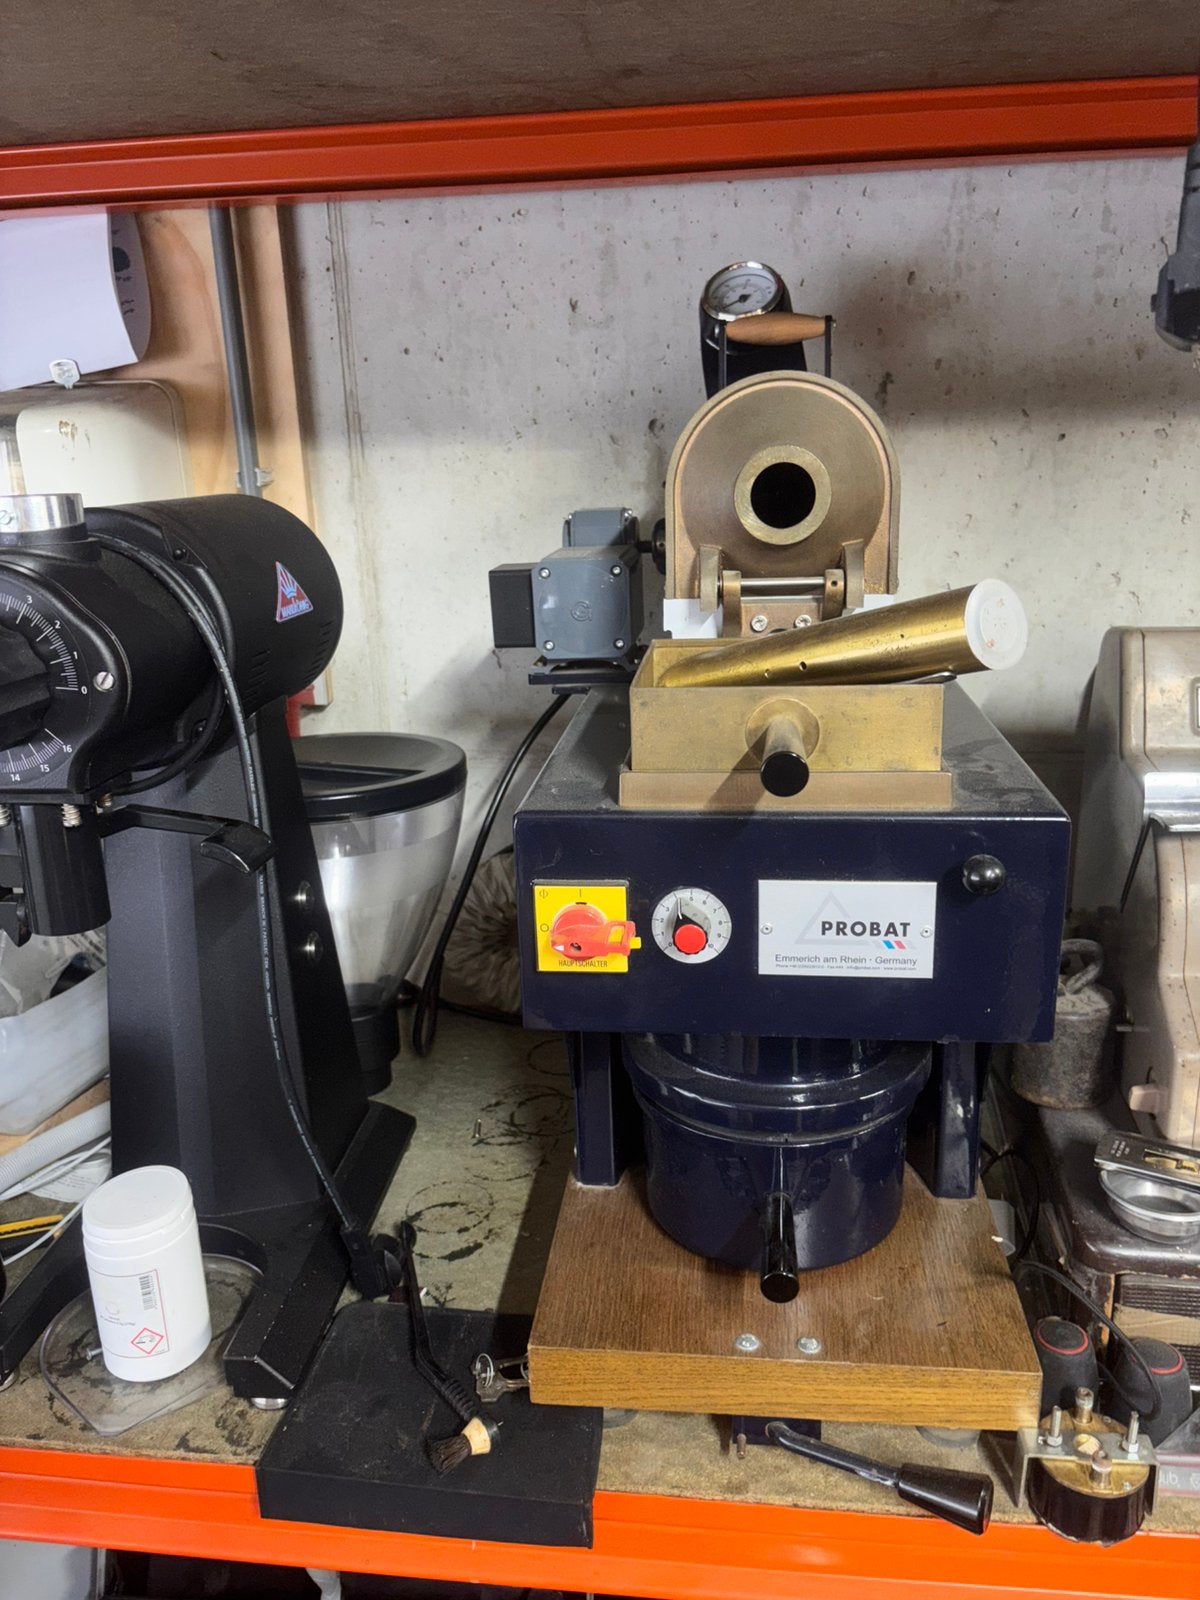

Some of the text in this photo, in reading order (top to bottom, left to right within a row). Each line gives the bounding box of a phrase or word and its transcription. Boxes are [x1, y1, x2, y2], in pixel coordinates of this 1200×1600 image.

[26, 595, 33, 604] 3
[54, 620, 61, 629] 2
[73, 651, 78, 659] 1
[81, 686, 88, 694] 0
[62, 745, 73, 753] 16
[40, 764, 50, 773] 15
[10, 774, 20, 782] 14
[821, 920, 910, 937] PROBAT
[559, 959, 608, 968] HAUPTSCHALTER
[775, 953, 918, 967] Emmerich am Rhein Germany
